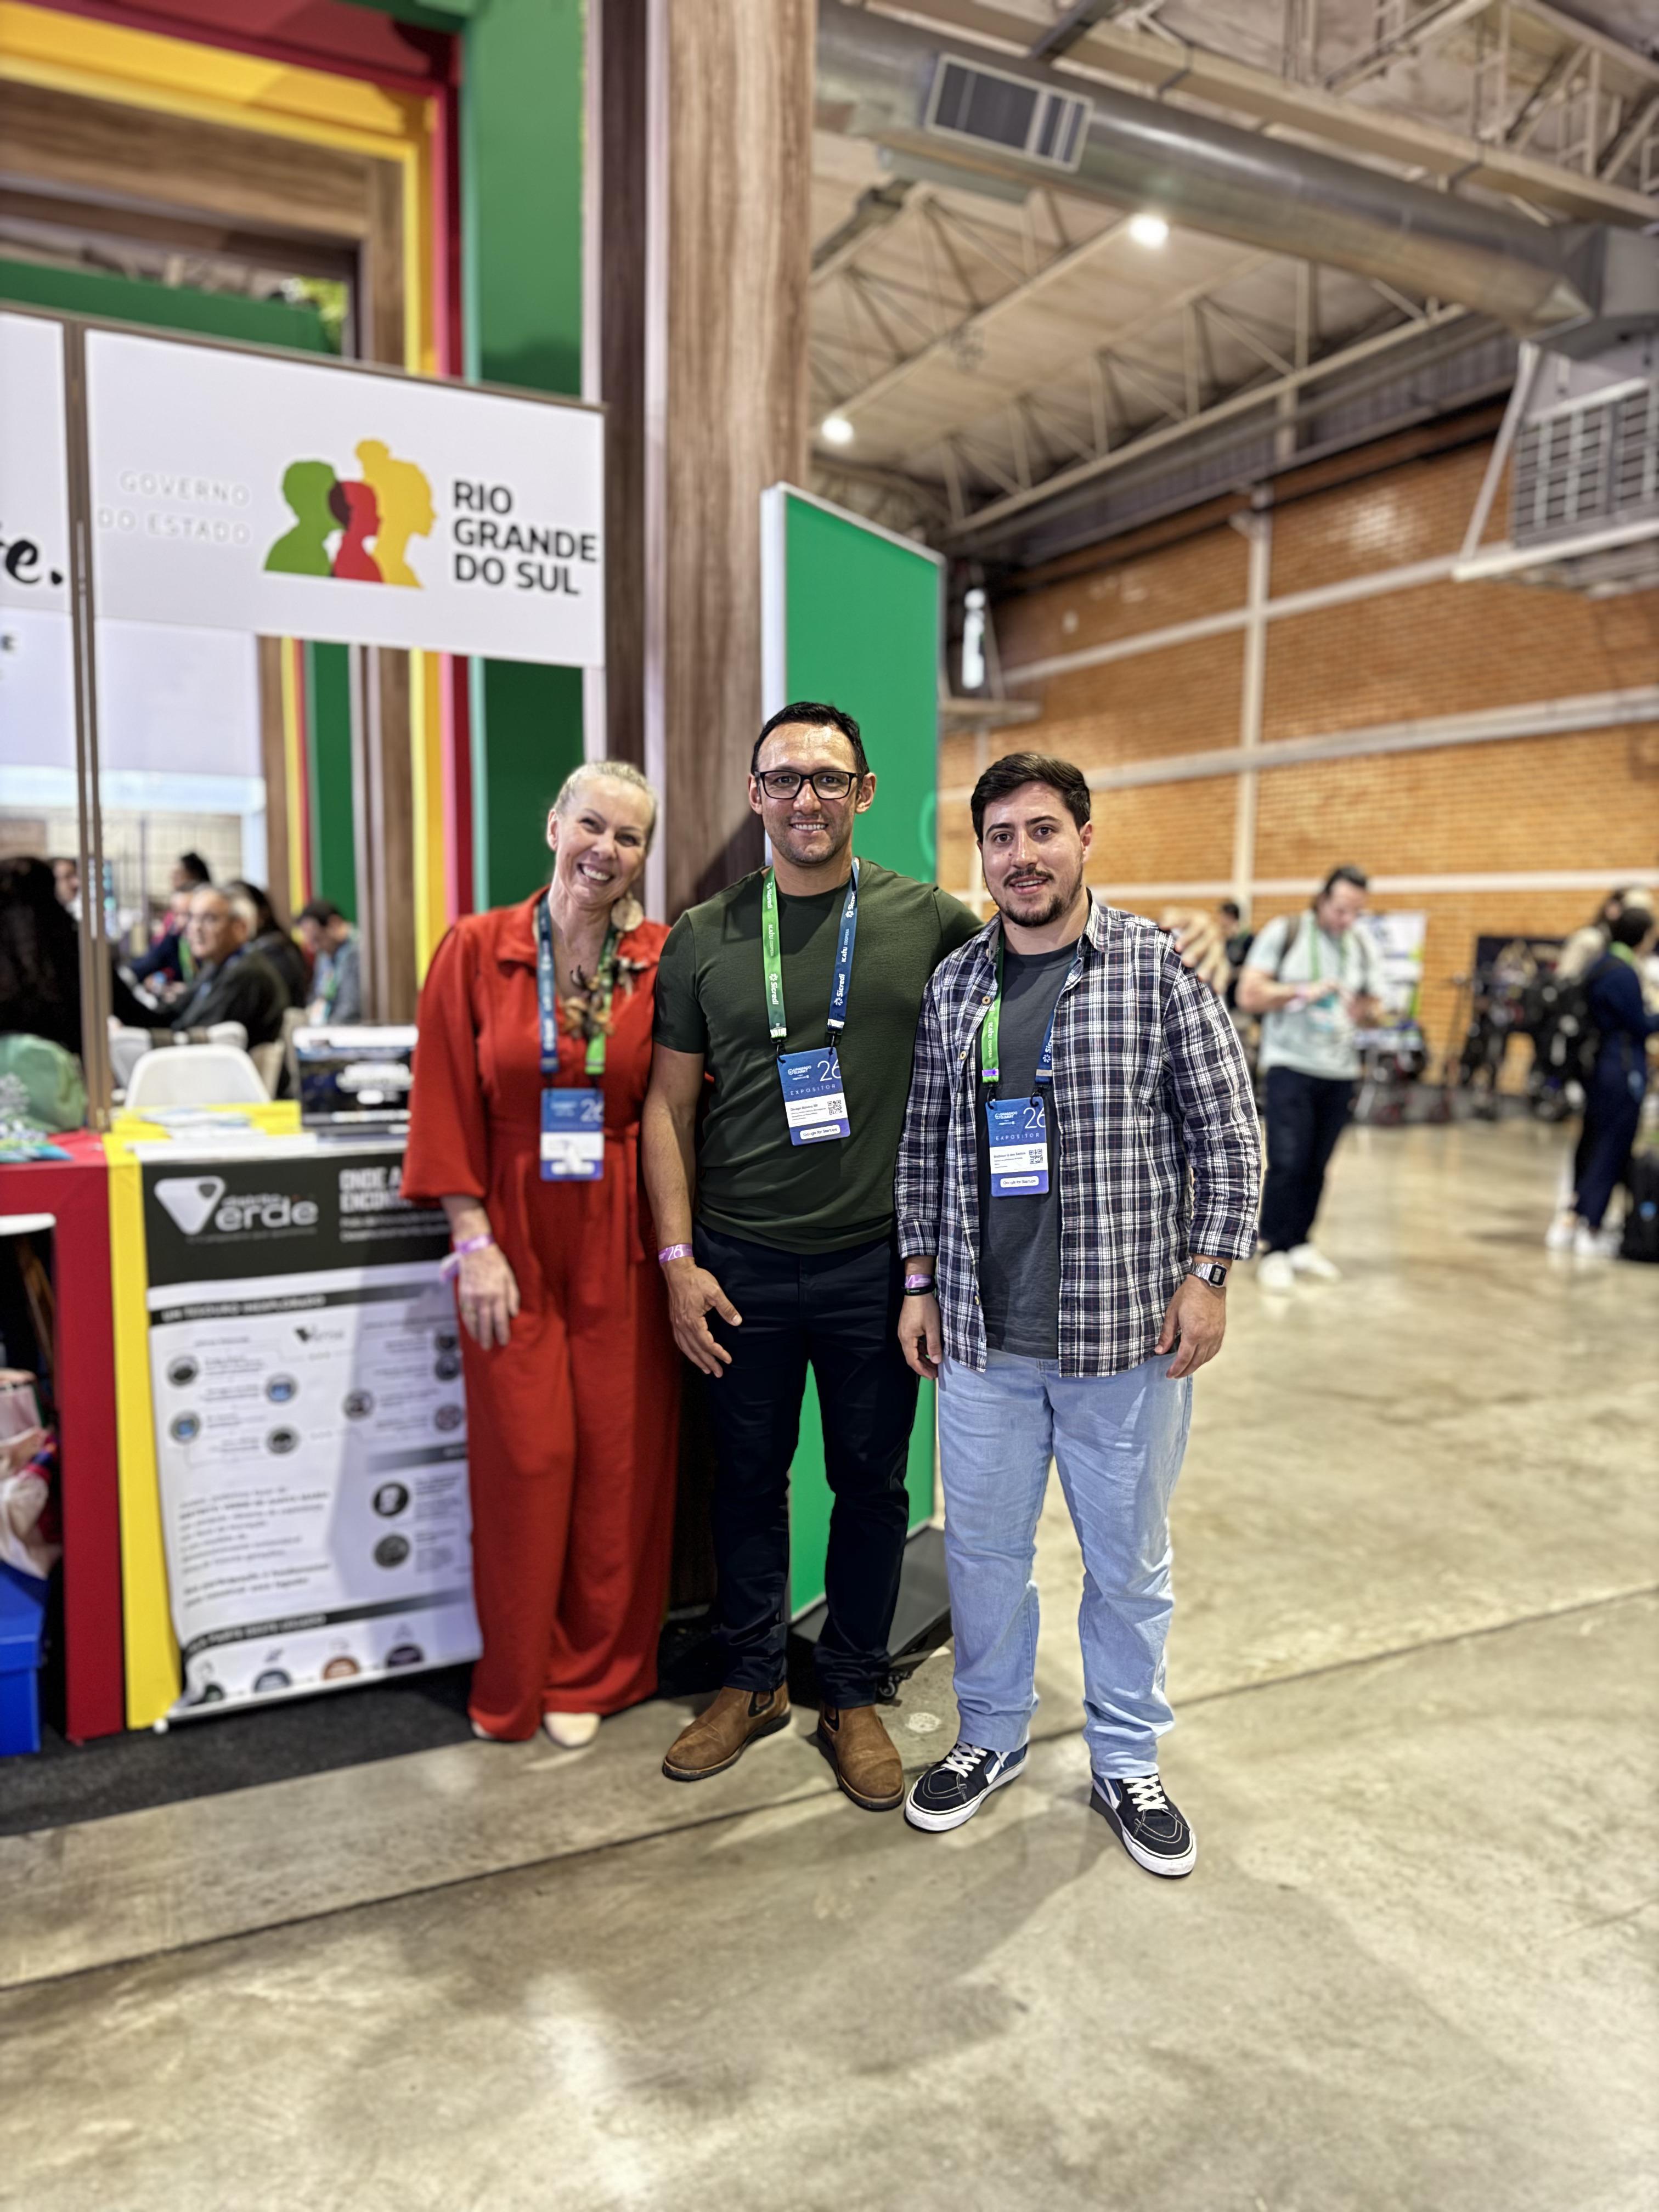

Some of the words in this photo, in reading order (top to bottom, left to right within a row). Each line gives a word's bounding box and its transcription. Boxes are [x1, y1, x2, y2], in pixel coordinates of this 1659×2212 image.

[454, 480, 512, 515] RIO
[454, 517, 597, 562] GRANDE
[455, 552, 505, 585] DO
[516, 560, 580, 595] SUL
[770, 981, 779, 1005] Sicredi
[837, 973, 845, 997] Sicredi
[817, 1059, 842, 1082] 26
[790, 1084, 836, 1096] EXPOSITOR
[1023, 1107, 1046, 1129] 26
[995, 1132, 1040, 1141] EXPOSITOR
